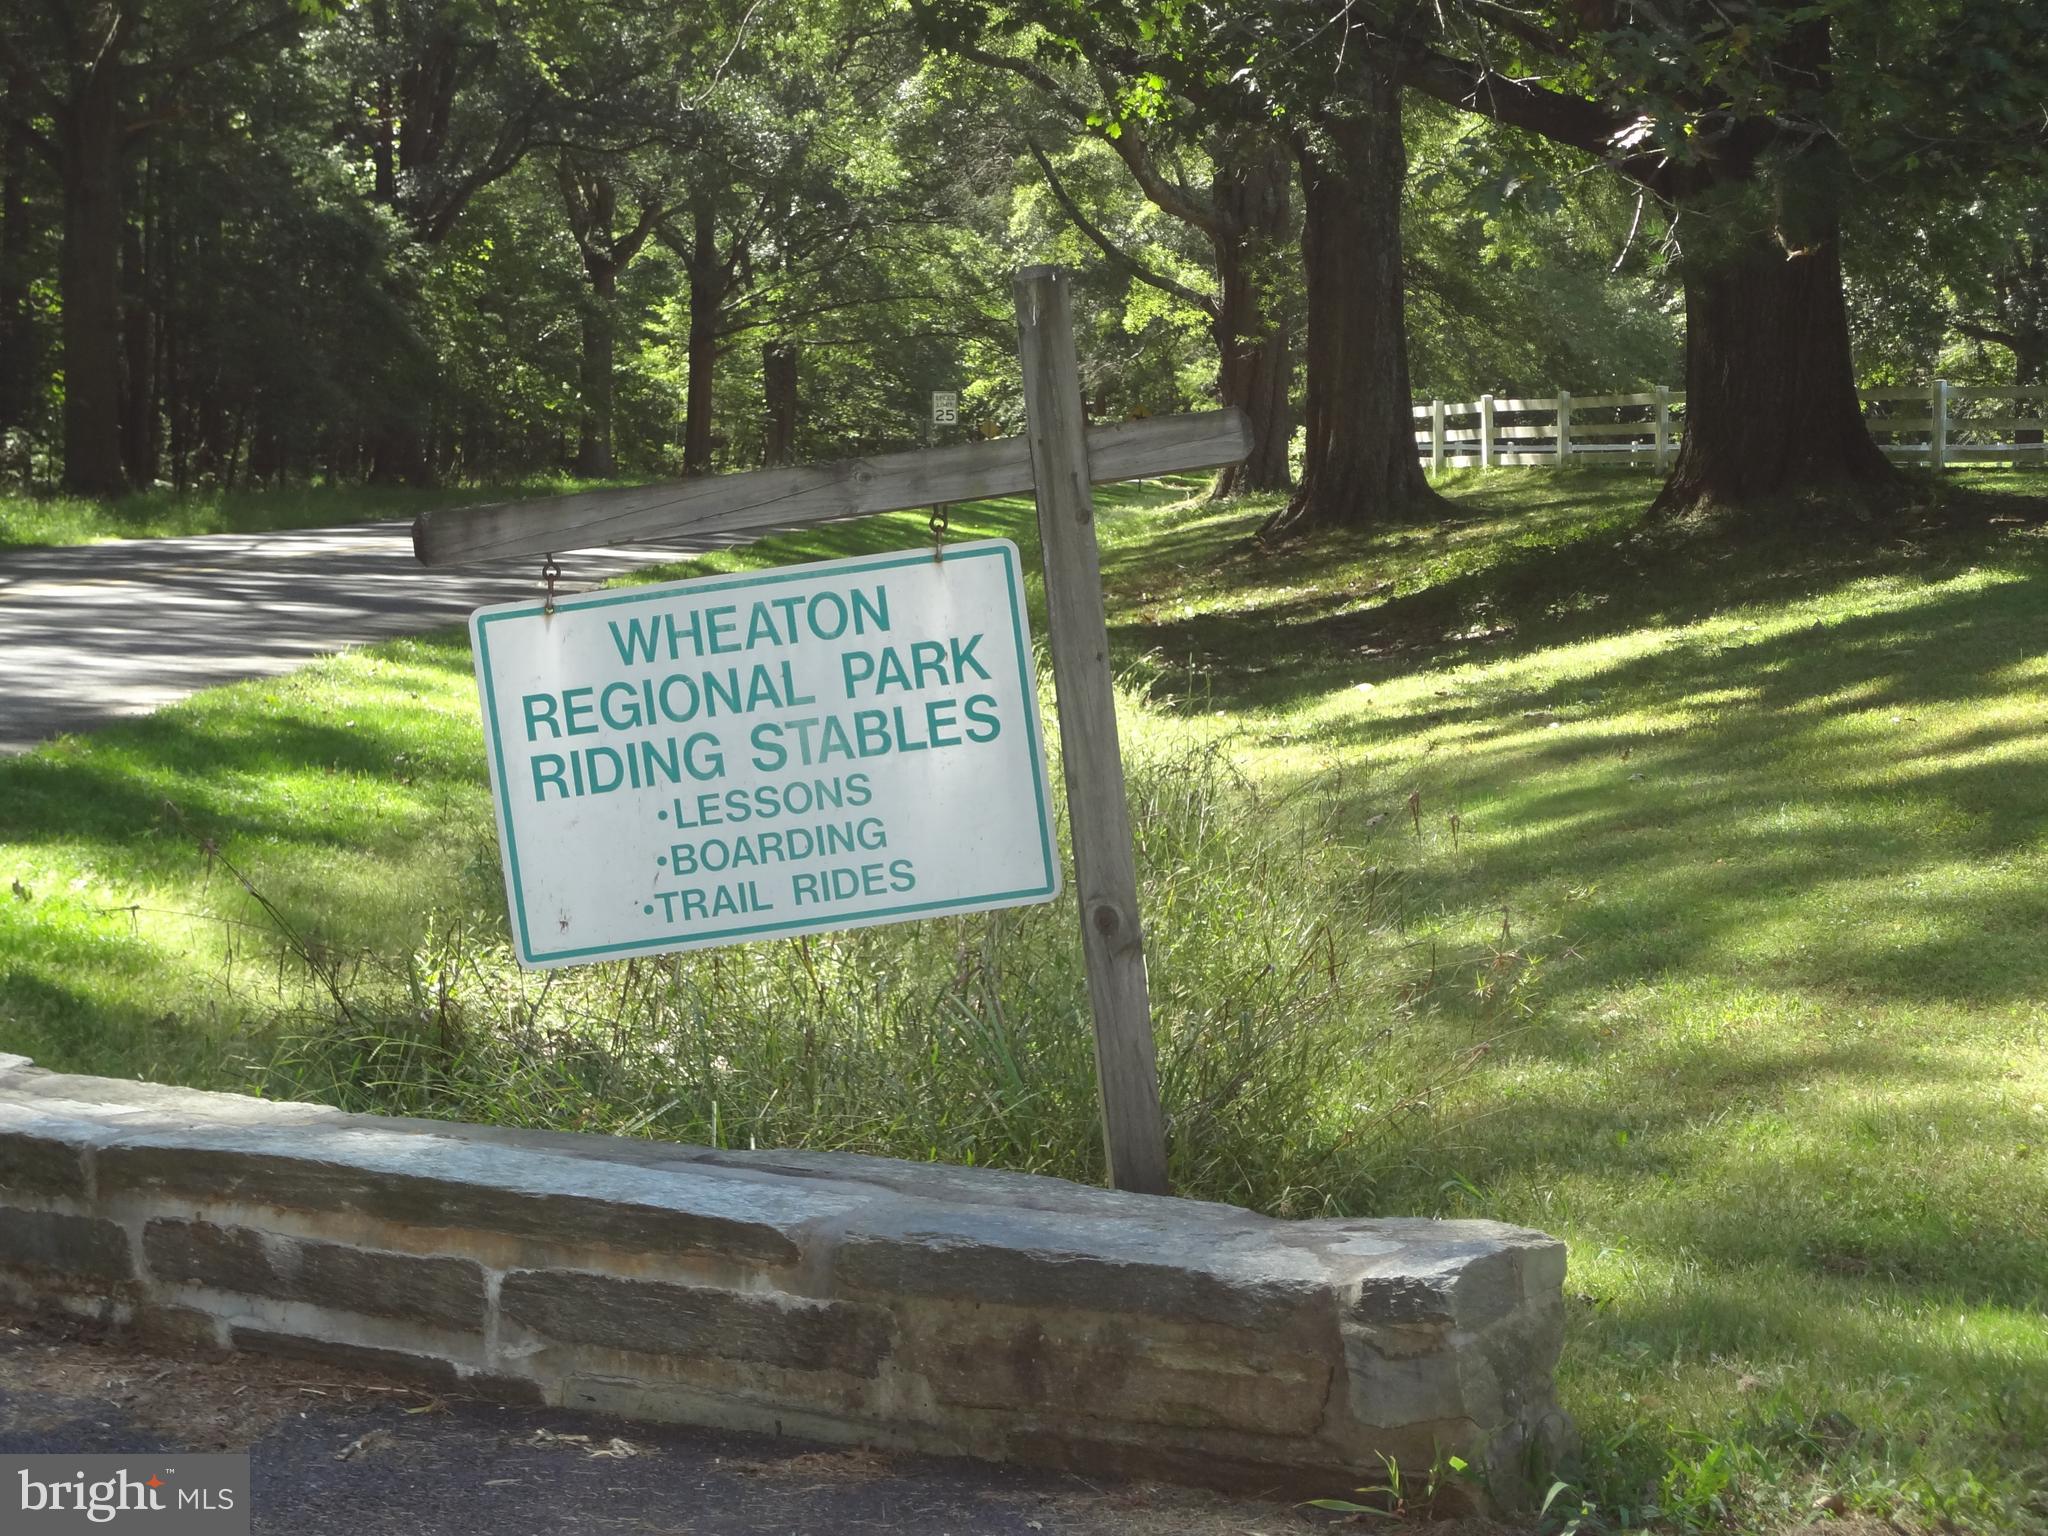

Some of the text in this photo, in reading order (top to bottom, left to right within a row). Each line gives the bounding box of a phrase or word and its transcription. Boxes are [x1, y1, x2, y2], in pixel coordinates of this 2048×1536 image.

[935, 409, 955, 421] 25
[608, 585, 891, 666] WHEATON
[522, 634, 992, 741] REGIONAL PARK
[530, 694, 1002, 802] RIDING STABLES
[674, 773, 872, 829] LESSONS
[671, 817, 887, 875] BOARDING
[654, 859, 917, 924] TRAIL RIDES
